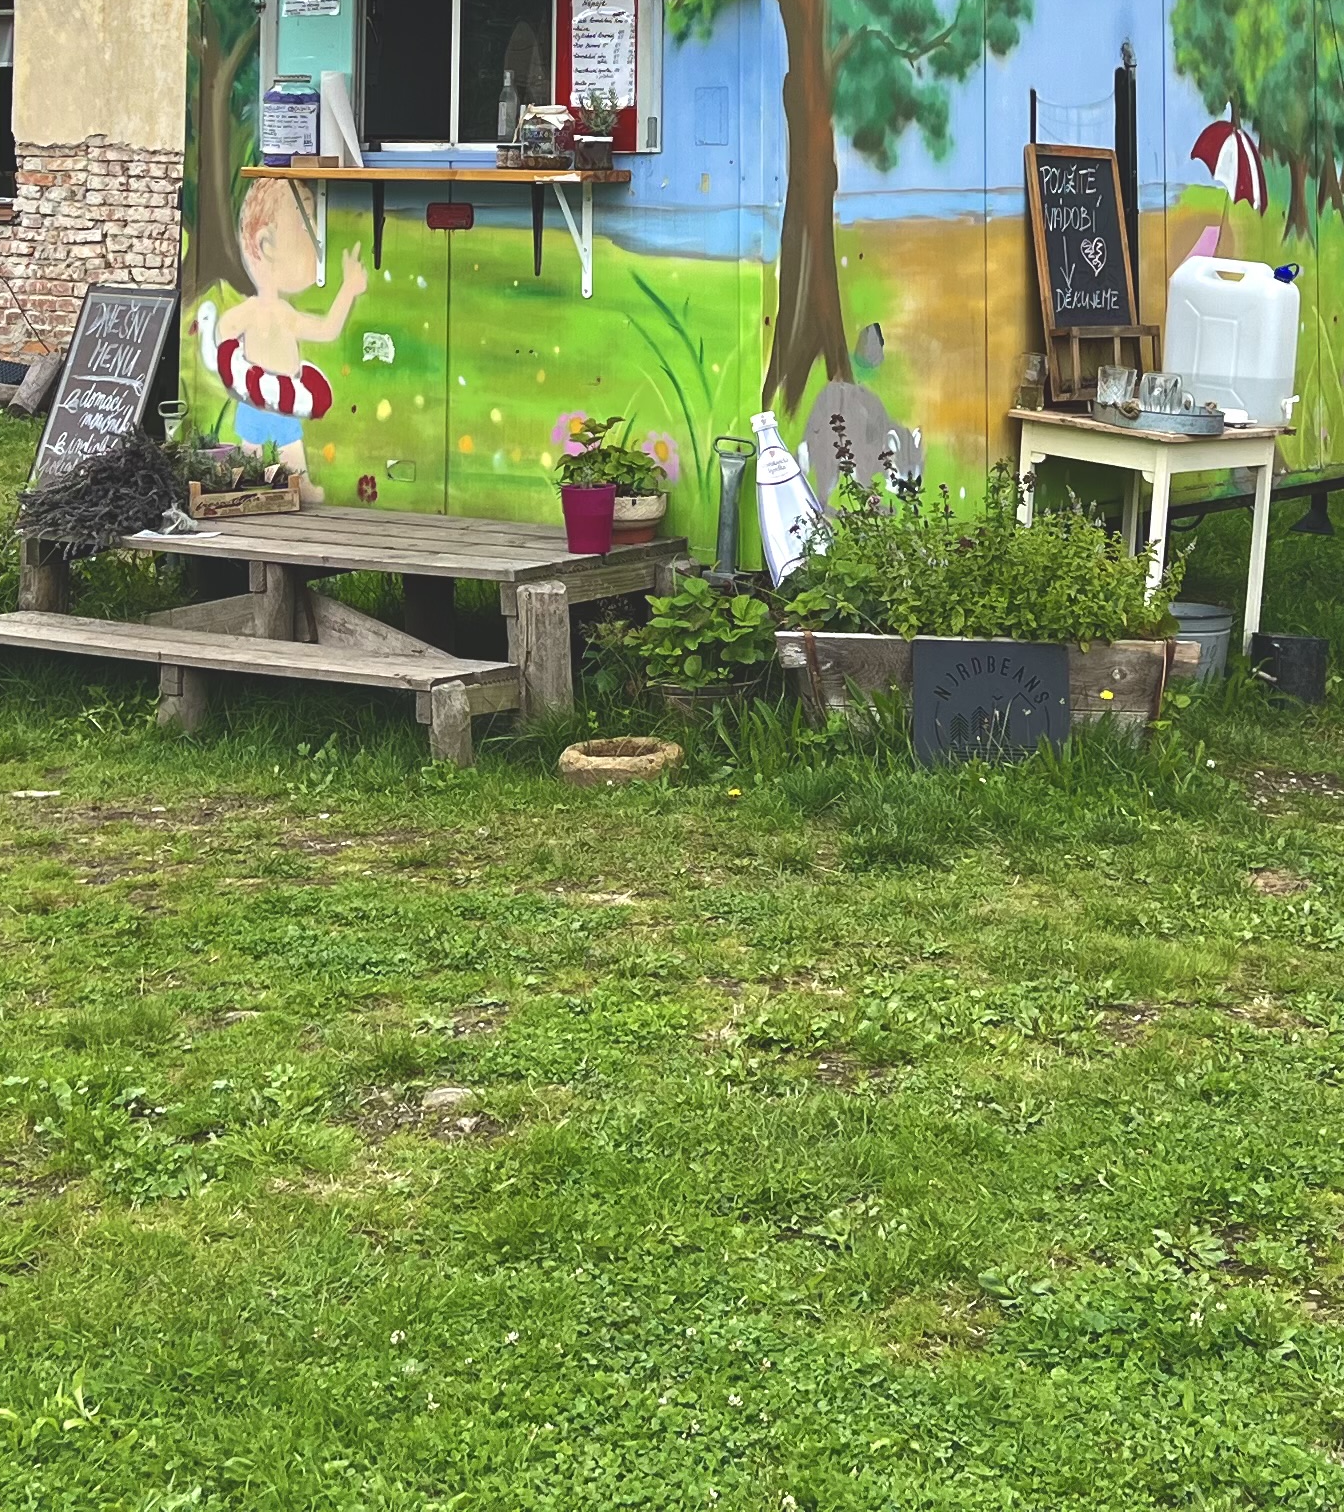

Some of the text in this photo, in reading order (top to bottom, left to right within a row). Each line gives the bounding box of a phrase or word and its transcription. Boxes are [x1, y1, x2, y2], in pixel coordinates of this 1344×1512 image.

[1040, 164, 1099, 194] POUŽITÉ
[1044, 195, 1102, 233] NÁDOBÍ
[1056, 288, 1119, 312] DĚKUJEME
[88, 339, 141, 377] MENU
[80, 383, 129, 411] domácí
